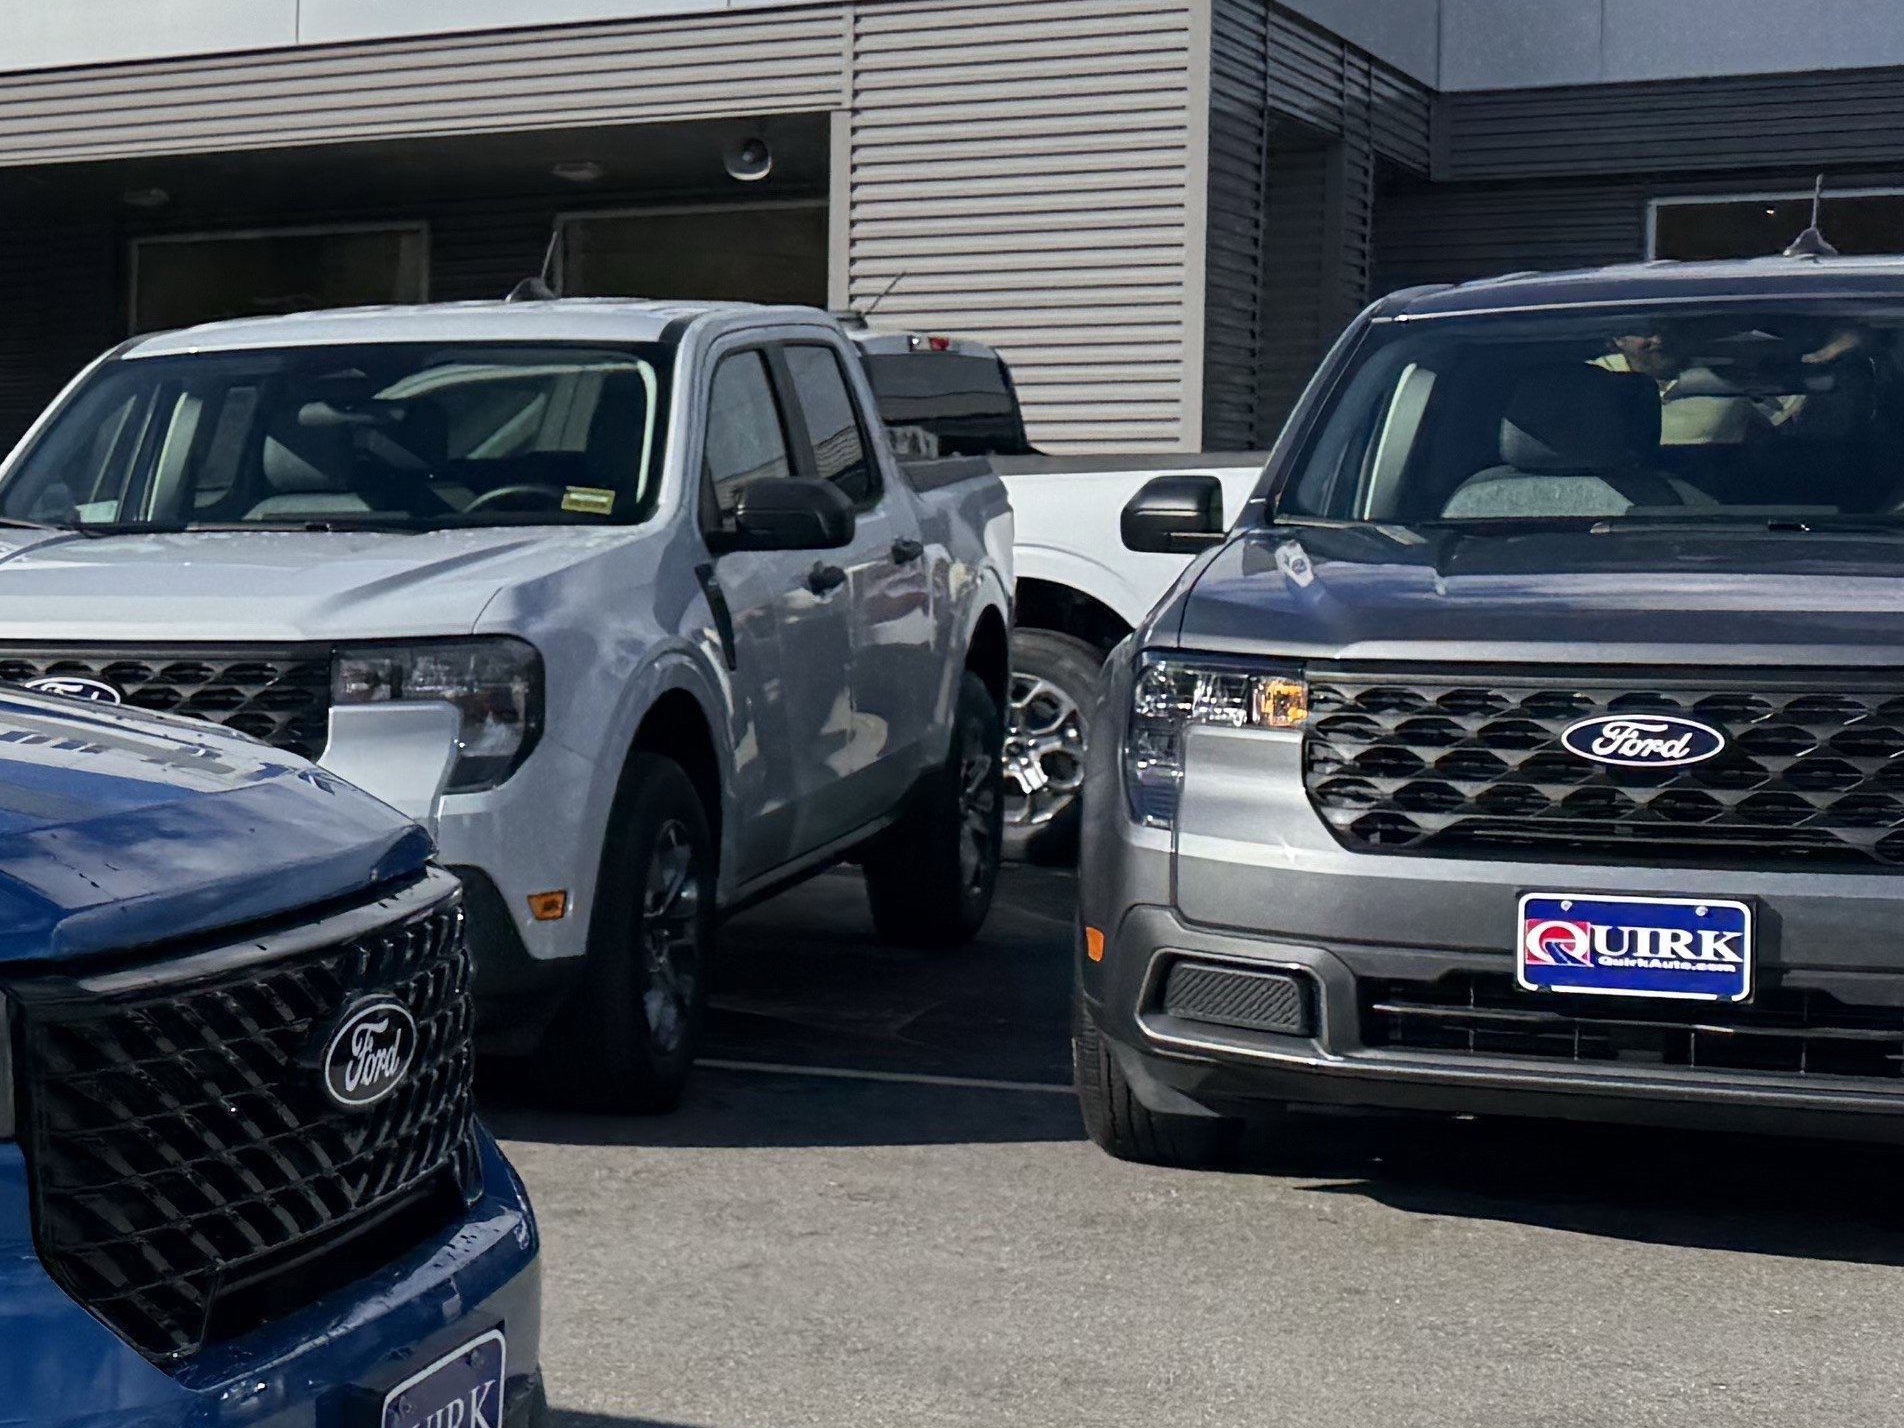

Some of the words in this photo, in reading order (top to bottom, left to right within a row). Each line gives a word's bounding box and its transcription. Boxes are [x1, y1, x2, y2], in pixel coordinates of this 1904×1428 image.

[1592, 721, 1693, 759] Ford
[1525, 919, 1744, 968] QUIRK
[1597, 955, 1737, 973] QuirkAuto.com
[344, 1017, 402, 1092] Ford
